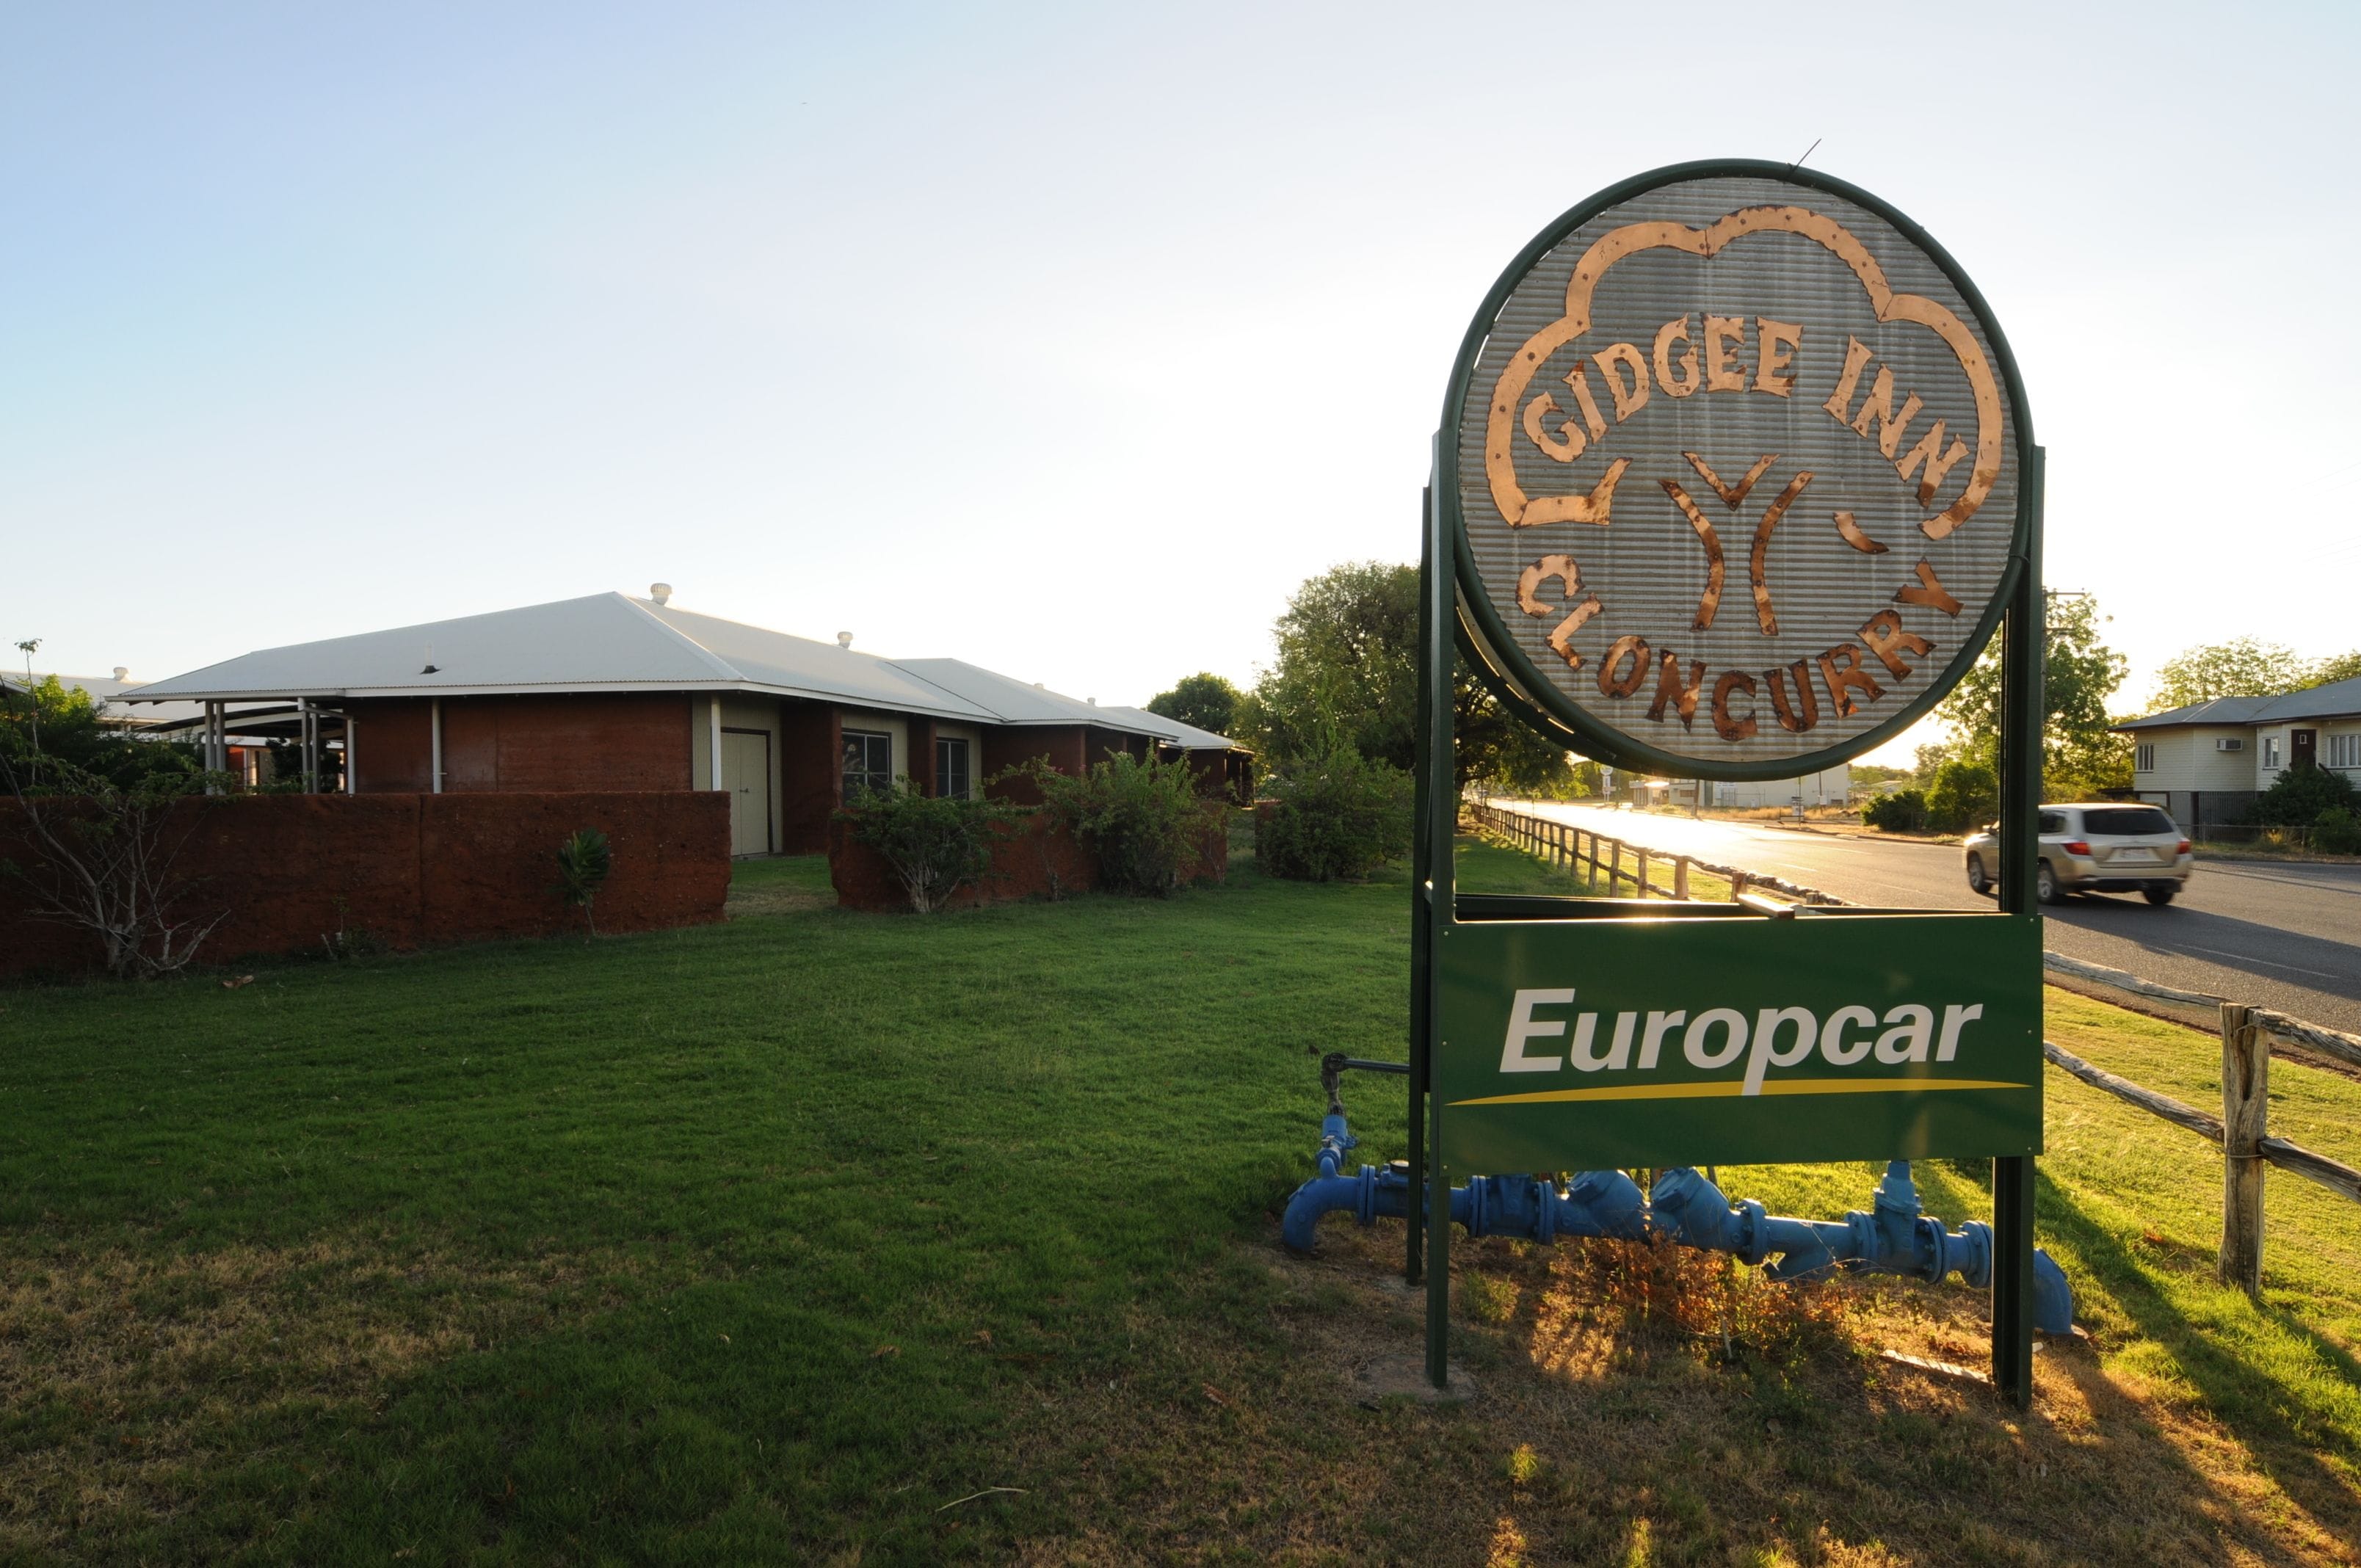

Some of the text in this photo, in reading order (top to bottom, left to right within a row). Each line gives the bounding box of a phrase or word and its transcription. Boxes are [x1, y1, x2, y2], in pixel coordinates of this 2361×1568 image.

[1523, 312, 1970, 509] GIDGEE INN
[1515, 555, 1965, 741] CLONCURRY
[1499, 988, 1984, 1096] Europcar
